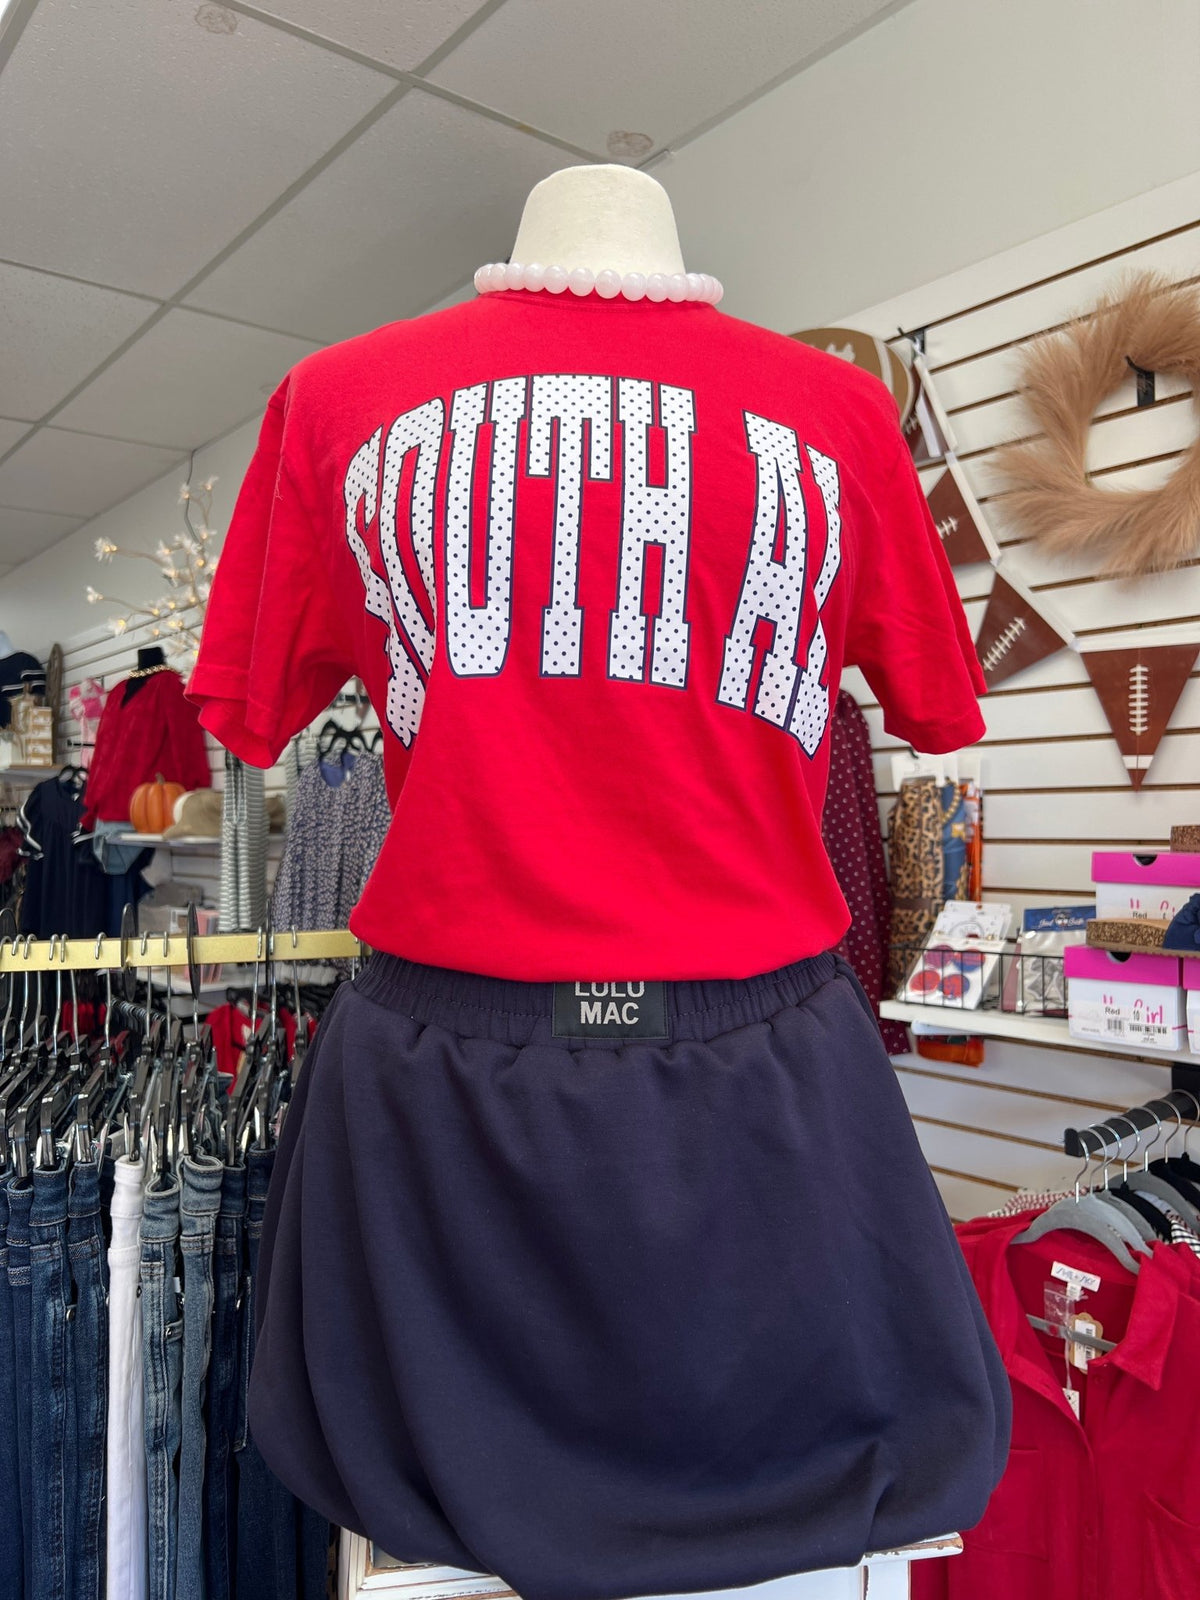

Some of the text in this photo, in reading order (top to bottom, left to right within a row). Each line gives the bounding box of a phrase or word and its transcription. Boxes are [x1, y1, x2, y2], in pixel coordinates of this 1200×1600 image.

[344, 374, 696, 750] SOUTH
[580, 1001, 639, 1025] MAC
[1104, 1006, 1121, 1016] Red
